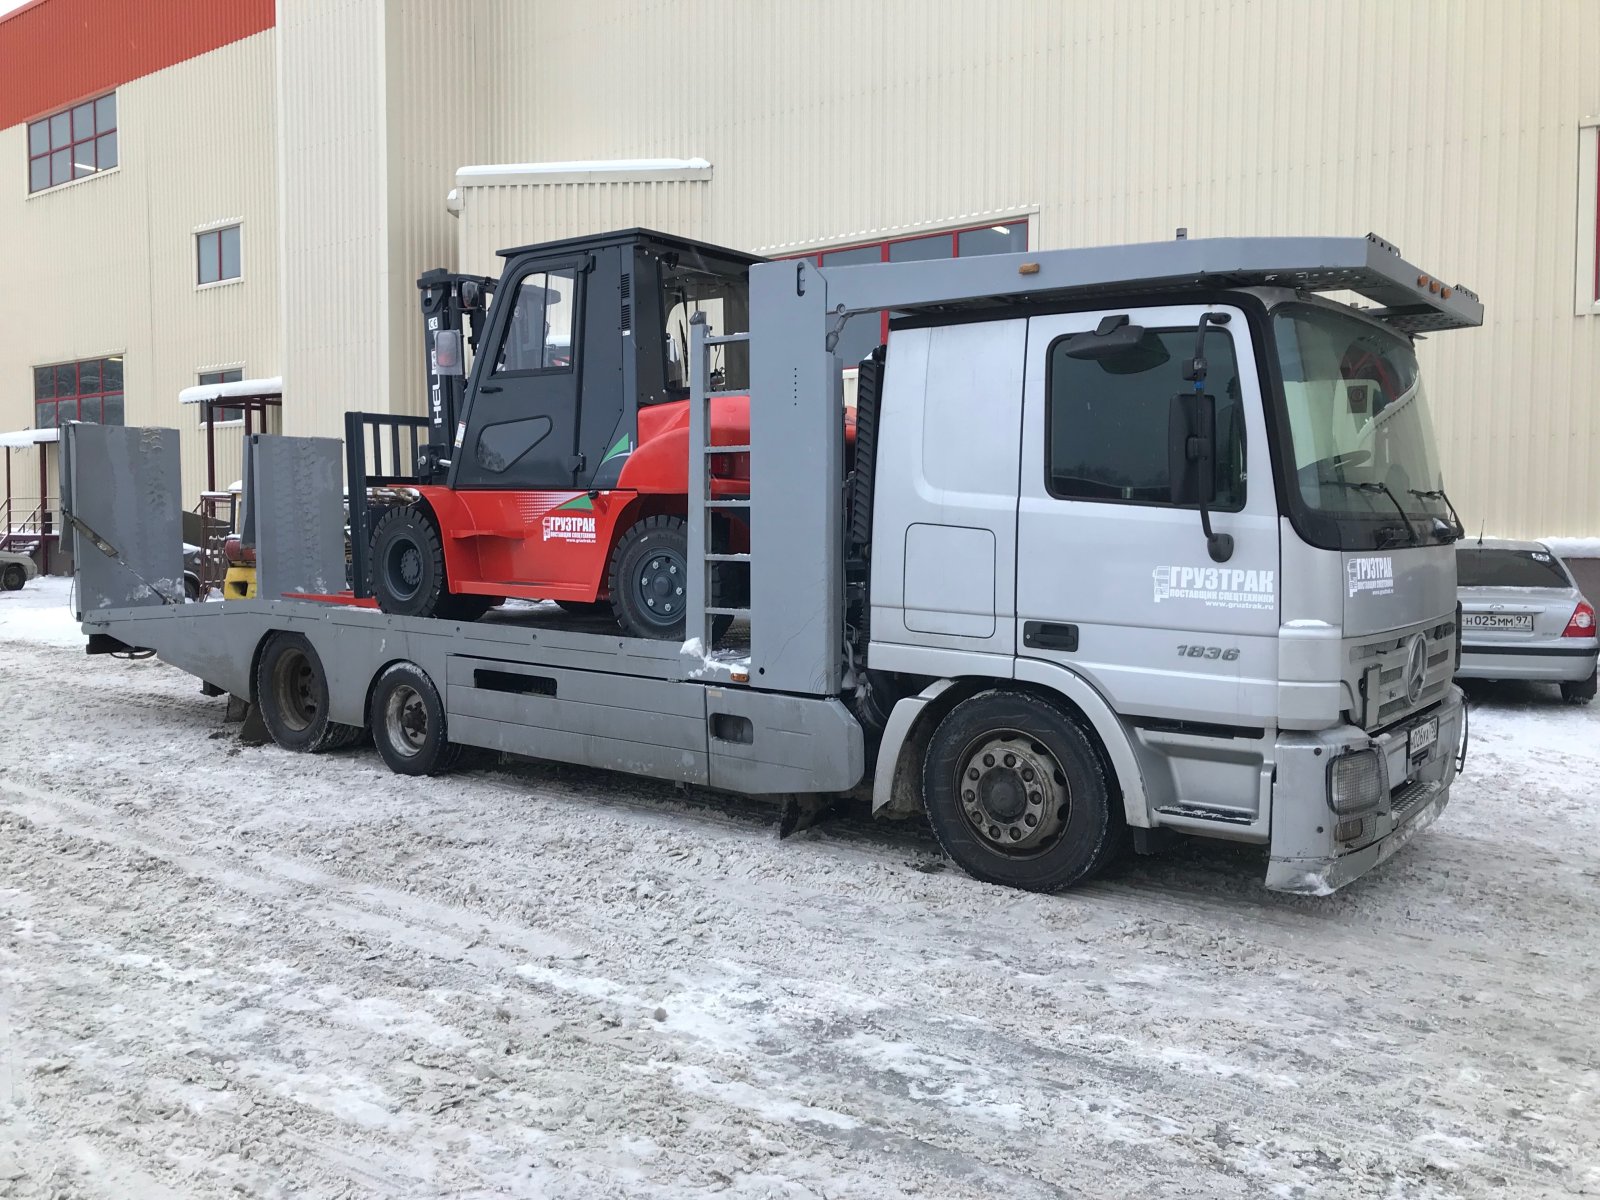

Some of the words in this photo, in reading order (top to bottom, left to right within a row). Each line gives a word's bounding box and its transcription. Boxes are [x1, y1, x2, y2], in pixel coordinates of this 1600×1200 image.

[550, 516, 596, 532] ГРУЗТРАК
[1356, 556, 1393, 580] ГРУЗТРАК
[1169, 566, 1274, 593] ГРУЗТРАК
[1169, 588, 1218, 600] ПОСТАВЩИК
[1218, 591, 1275, 603] СПЕЦТЕХНИКИ
[1176, 644, 1241, 661] 1836
